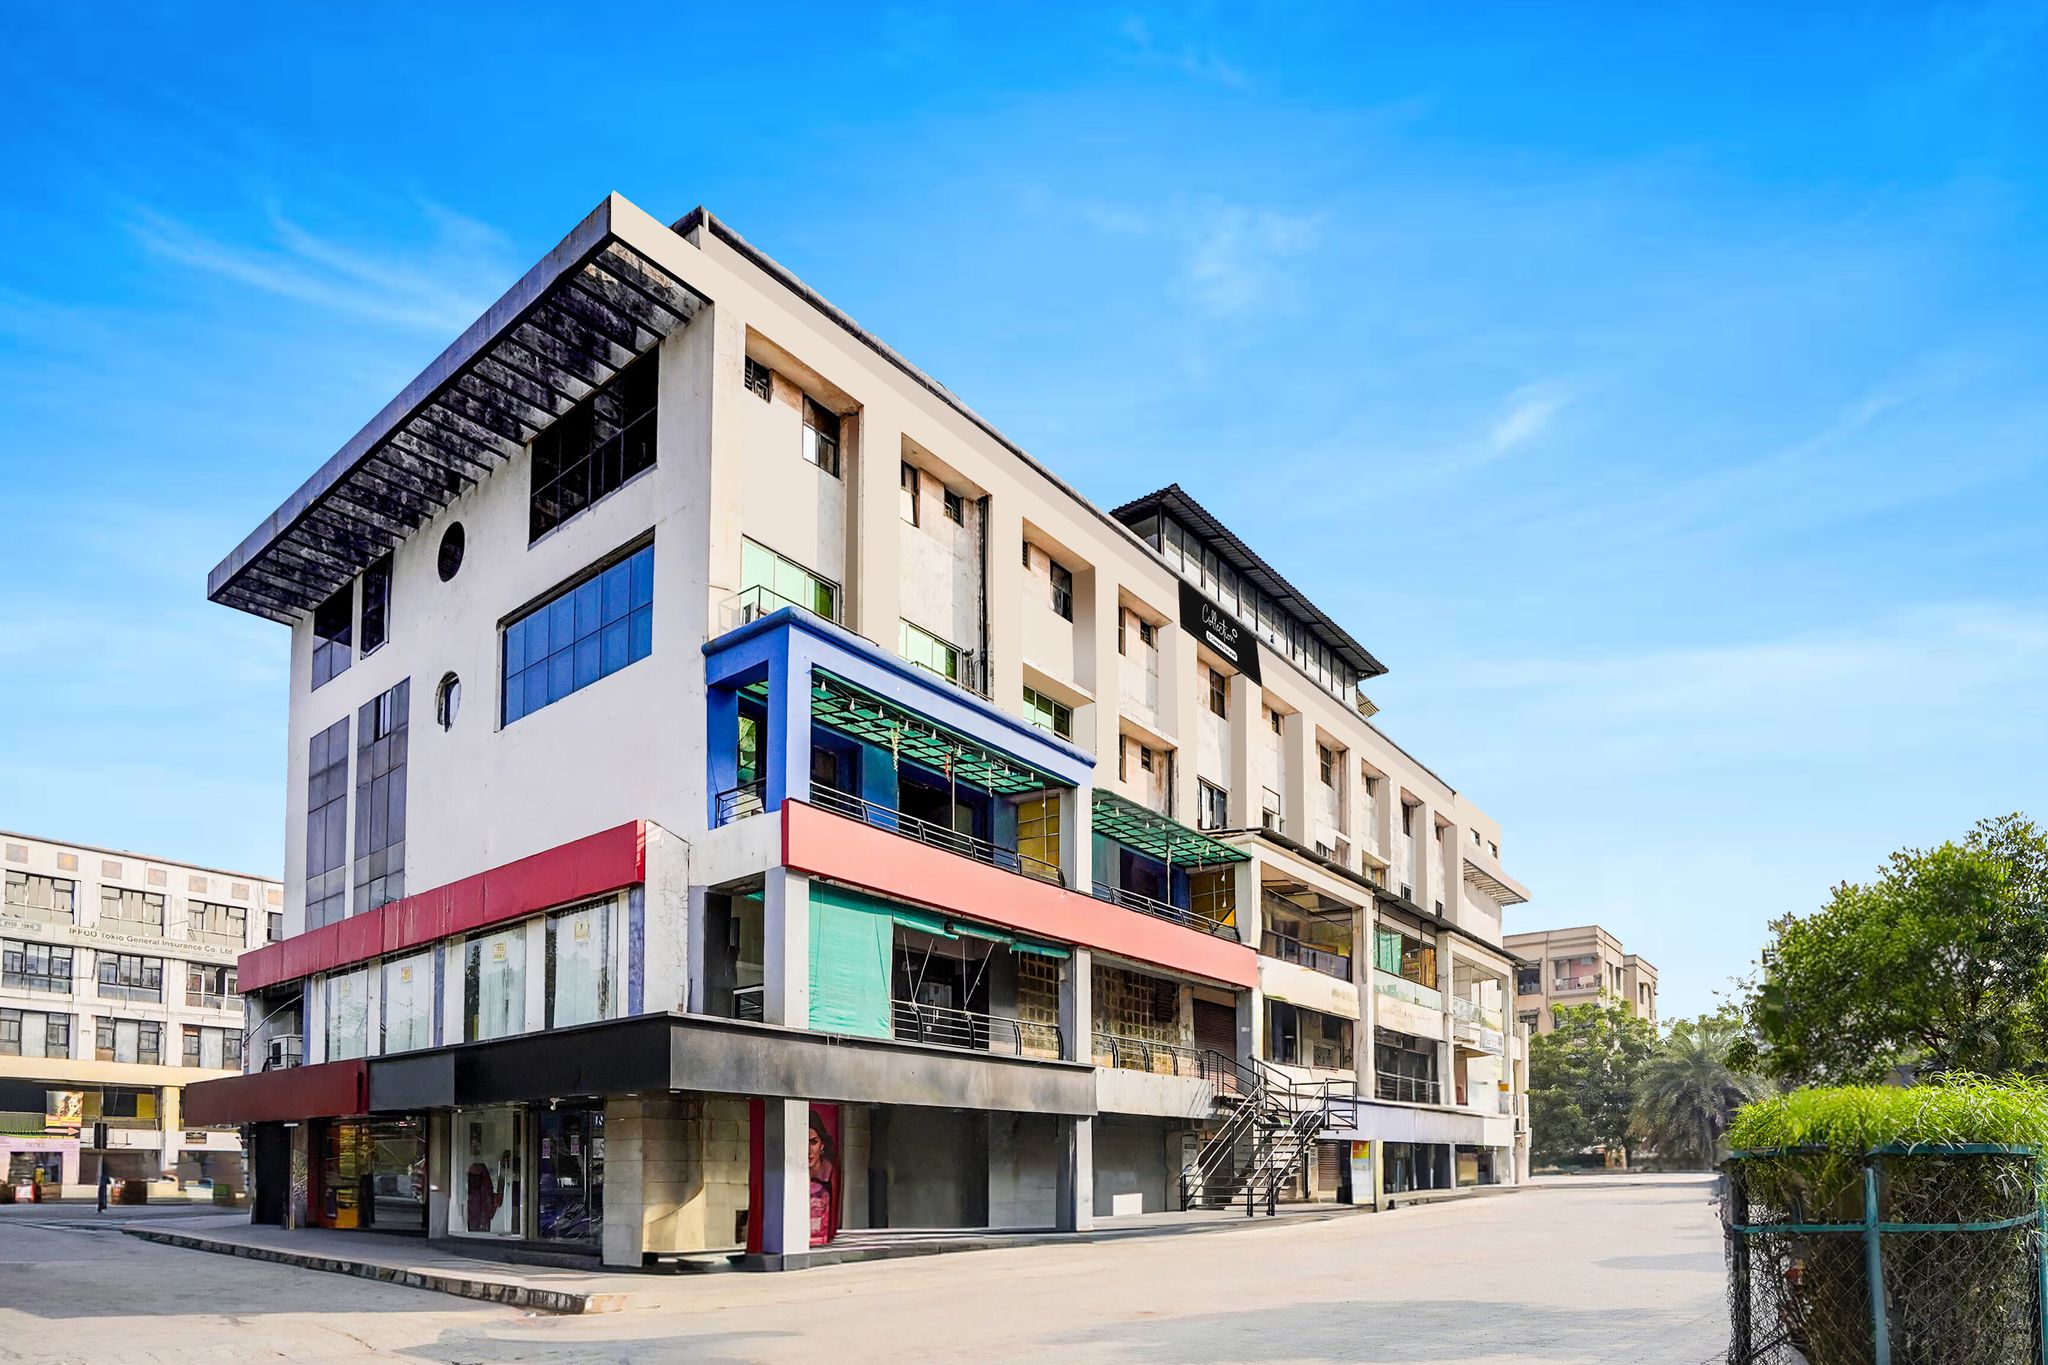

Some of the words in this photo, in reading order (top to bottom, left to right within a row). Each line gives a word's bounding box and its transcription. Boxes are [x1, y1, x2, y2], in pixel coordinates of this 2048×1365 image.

[1202, 603, 1236, 644] Collection
[101, 932, 125, 942] Tokio
[126, 935, 160, 946] General
[161, 940, 203, 951] Insurance
